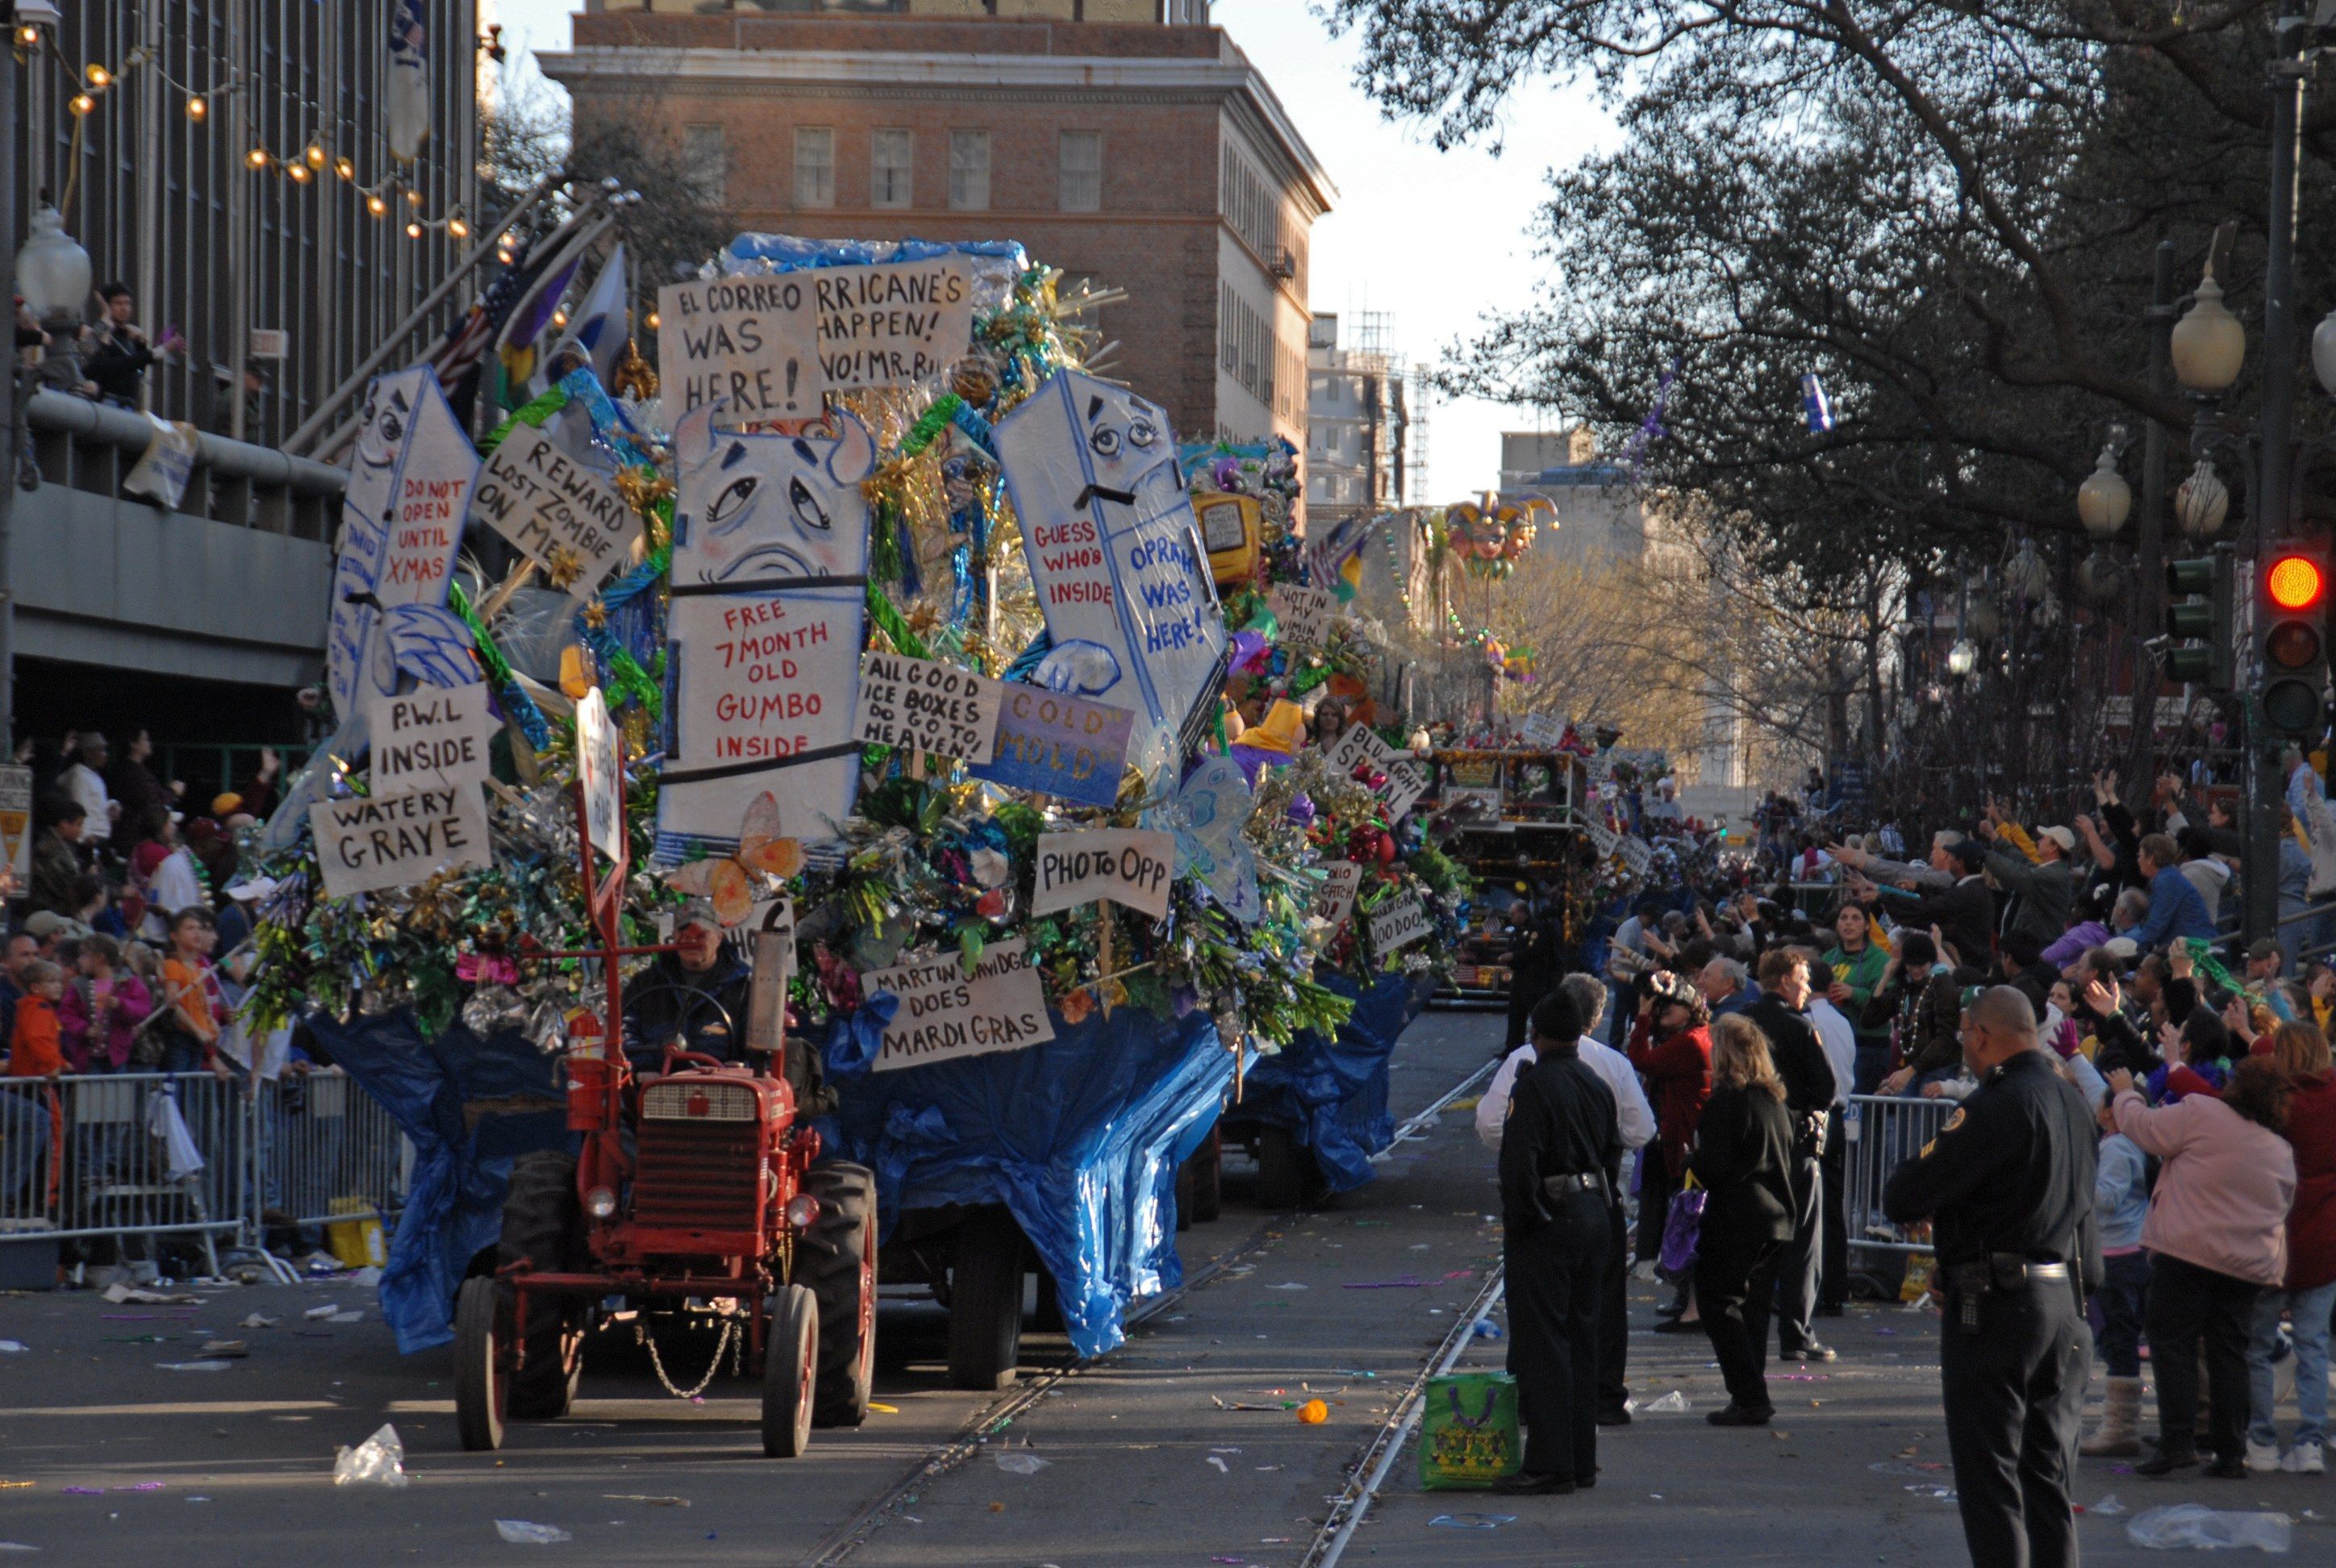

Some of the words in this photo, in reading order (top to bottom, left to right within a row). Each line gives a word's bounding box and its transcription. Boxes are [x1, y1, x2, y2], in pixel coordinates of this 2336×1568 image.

[679, 290, 699, 315] EL
[707, 282, 802, 313] CORREO
[816, 267, 962, 313] RRICANE'S
[683, 318, 762, 360] WAS
[685, 357, 799, 415] HERE!
[405, 479, 423, 498] DO
[428, 479, 467, 499] NOT
[527, 440, 625, 532] REWARD
[403, 501, 450, 523] OPEN
[476, 484, 516, 523] ON
[515, 517, 561, 560] ME
[487, 453, 542, 499] LOST
[536, 488, 612, 560] ZOMBIE
[398, 528, 450, 549] UNTIL
[1034, 521, 1096, 548] GUESS
[385, 554, 445, 586] XMAS
[1130, 536, 1194, 574] OPRAH
[1049, 581, 1113, 605] INSIDE
[1140, 578, 1191, 610] WAS
[1291, 603, 1313, 619] MY
[1309, 594, 1328, 609] IN
[724, 598, 786, 632] FREE
[1145, 606, 1205, 654] HERE!
[715, 641, 734, 669] 7
[738, 620, 828, 664] MONTH
[748, 659, 799, 683] OLD
[907, 662, 979, 698] GOOD
[716, 692, 821, 724] GUMBO
[864, 682, 896, 704] ICE
[903, 688, 981, 724] BOXES
[870, 703, 895, 722] DO
[907, 711, 941, 735] GO
[949, 723, 977, 744] TO
[381, 736, 476, 775] INSIDE
[715, 735, 809, 758] INSIDE
[864, 723, 982, 761] HEAVEN!
[1352, 726, 1383, 764] BLU
[332, 788, 457, 828] WATERY
[876, 962, 957, 992] MARTIN
[909, 985, 971, 1018] DOES
[882, 1020, 968, 1059] MARDI
[970, 1013, 1040, 1046] GRAS
